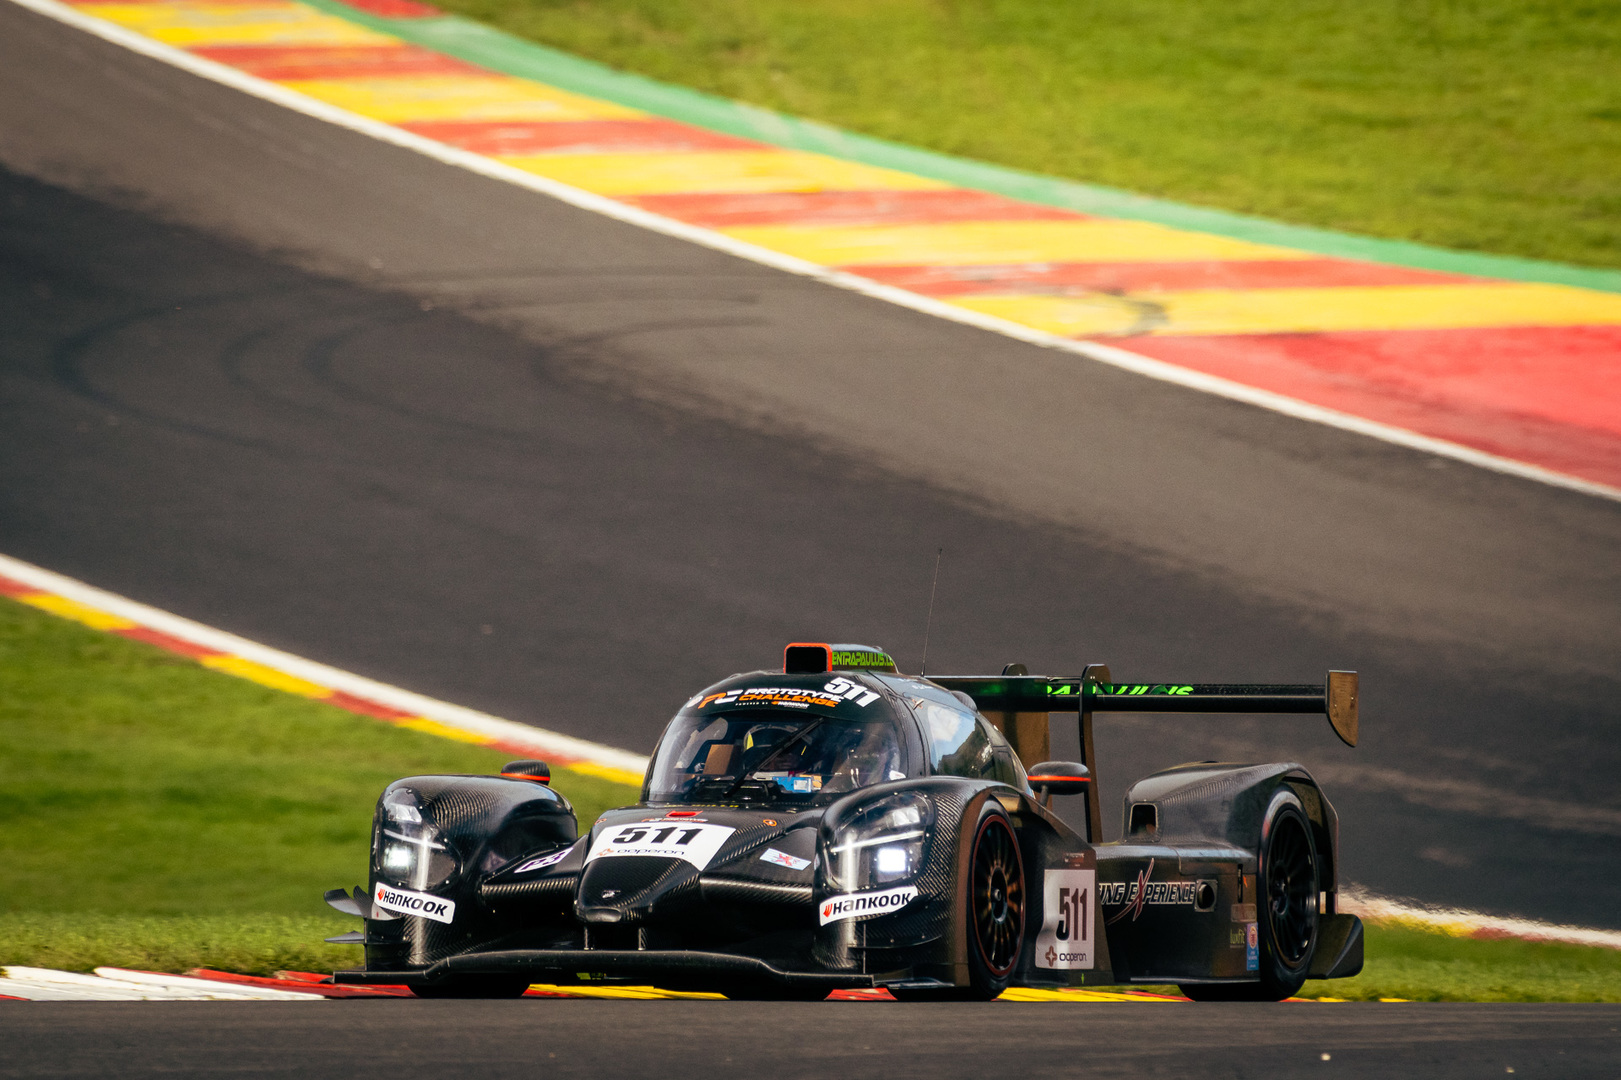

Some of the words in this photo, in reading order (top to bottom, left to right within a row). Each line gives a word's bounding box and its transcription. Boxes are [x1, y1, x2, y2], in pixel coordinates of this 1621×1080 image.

[738, 694, 839, 708] CHALLENGE
[744, 688, 846, 703] PROTOTYPE
[823, 677, 881, 707] 511
[612, 826, 703, 845] 511
[1056, 887, 1087, 941] 511
